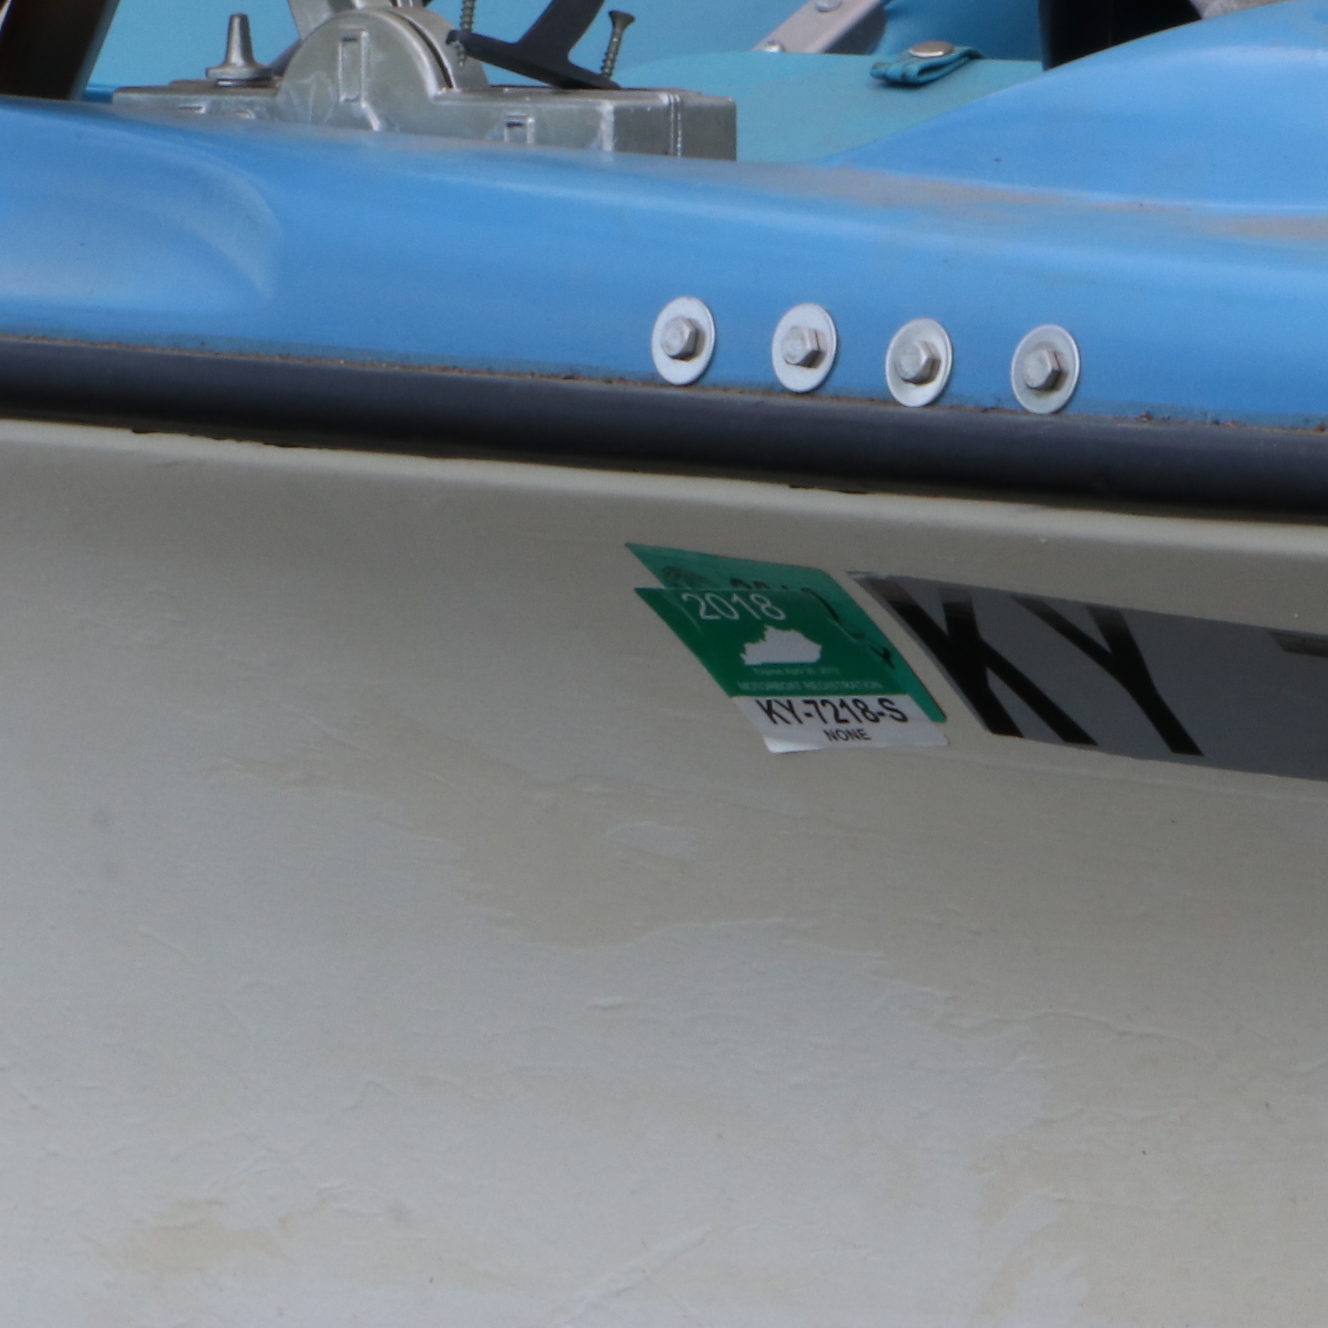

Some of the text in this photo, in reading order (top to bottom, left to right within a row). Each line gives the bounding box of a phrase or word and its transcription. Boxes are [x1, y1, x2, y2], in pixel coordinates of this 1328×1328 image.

[681, 593, 786, 620] 2018
[872, 574, 1204, 757] KY
[755, 698, 910, 725] KY-7218-S
[824, 728, 872, 742] NONE
